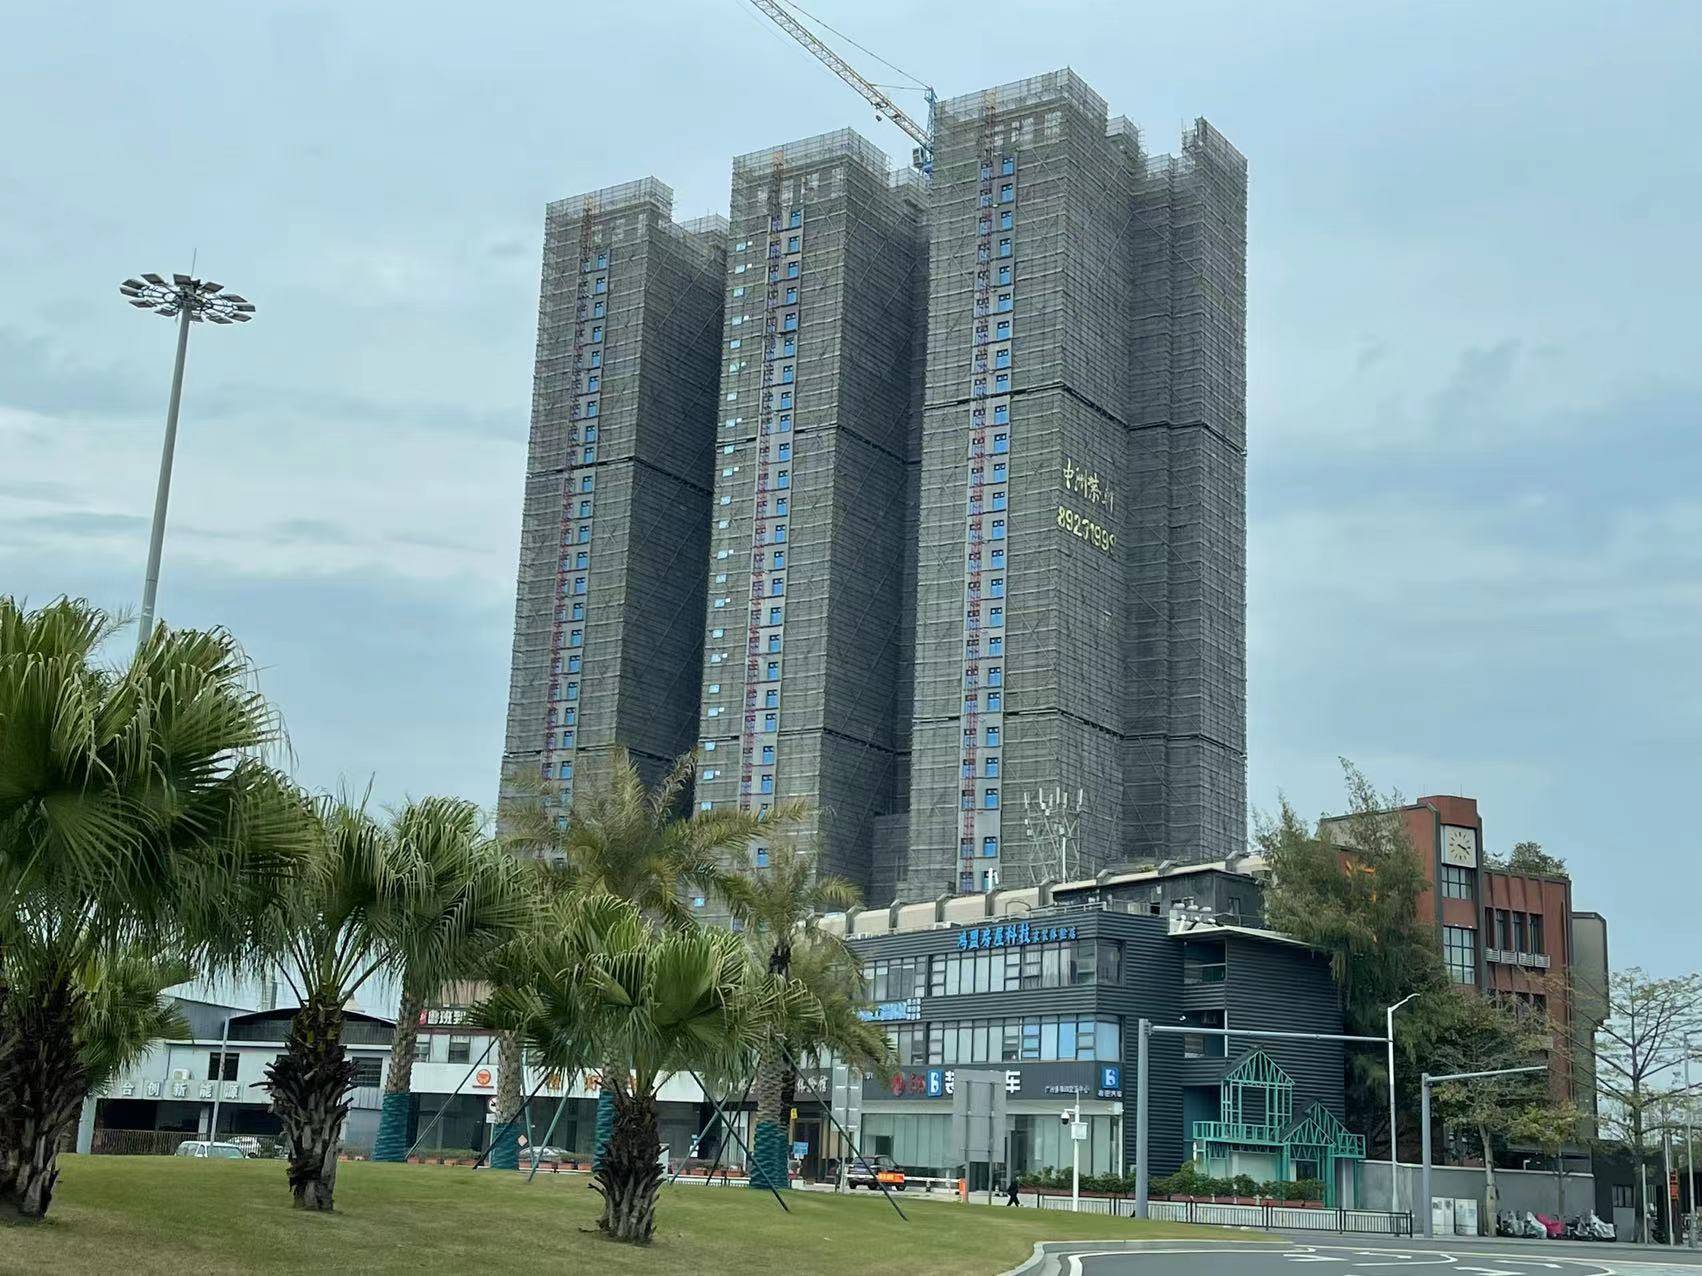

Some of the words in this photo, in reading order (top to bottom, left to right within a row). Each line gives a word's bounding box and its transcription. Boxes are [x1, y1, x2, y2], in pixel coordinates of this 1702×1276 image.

[103, 1081, 240, 1100] 合创新能源
